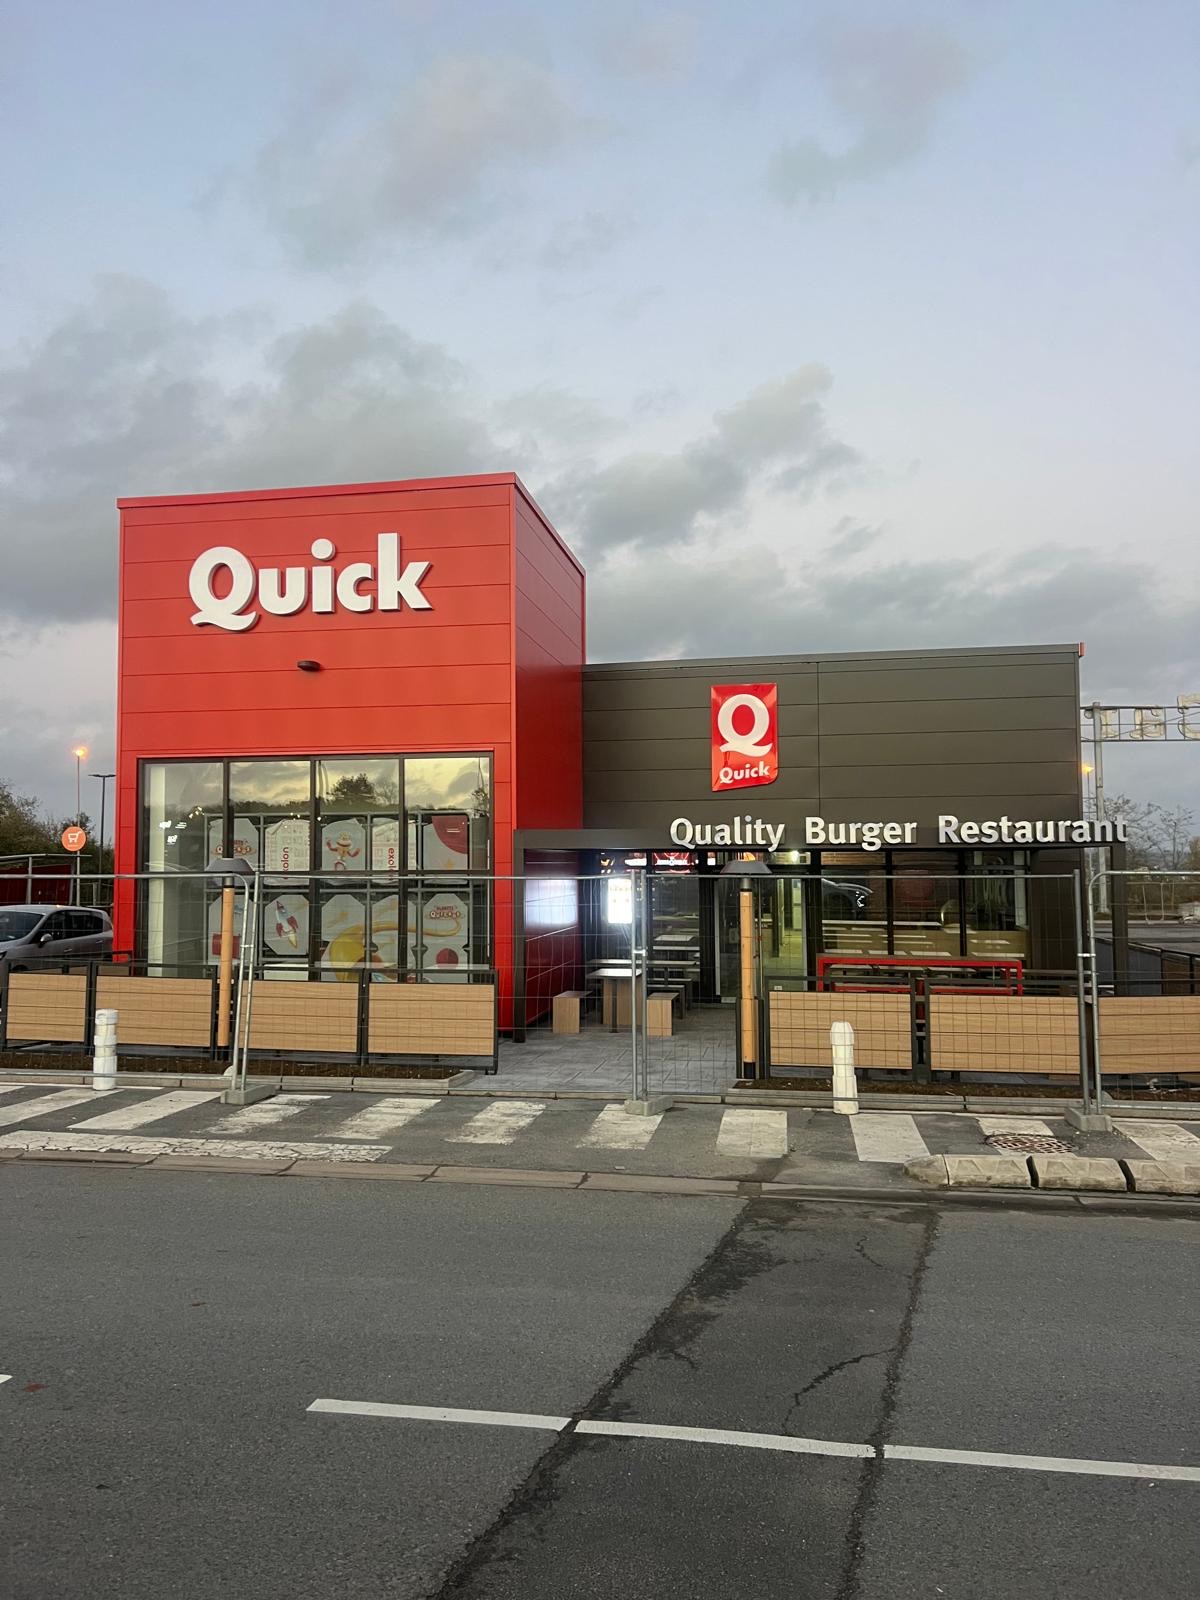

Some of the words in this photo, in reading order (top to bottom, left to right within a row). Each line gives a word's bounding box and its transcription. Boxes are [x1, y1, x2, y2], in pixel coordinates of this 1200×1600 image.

[188, 532, 433, 631] Quick
[717, 693, 773, 758] Q
[719, 761, 770, 784] Quick
[669, 814, 786, 853] Quality
[805, 816, 918, 851] Burger
[938, 814, 1128, 844] Restaurant
